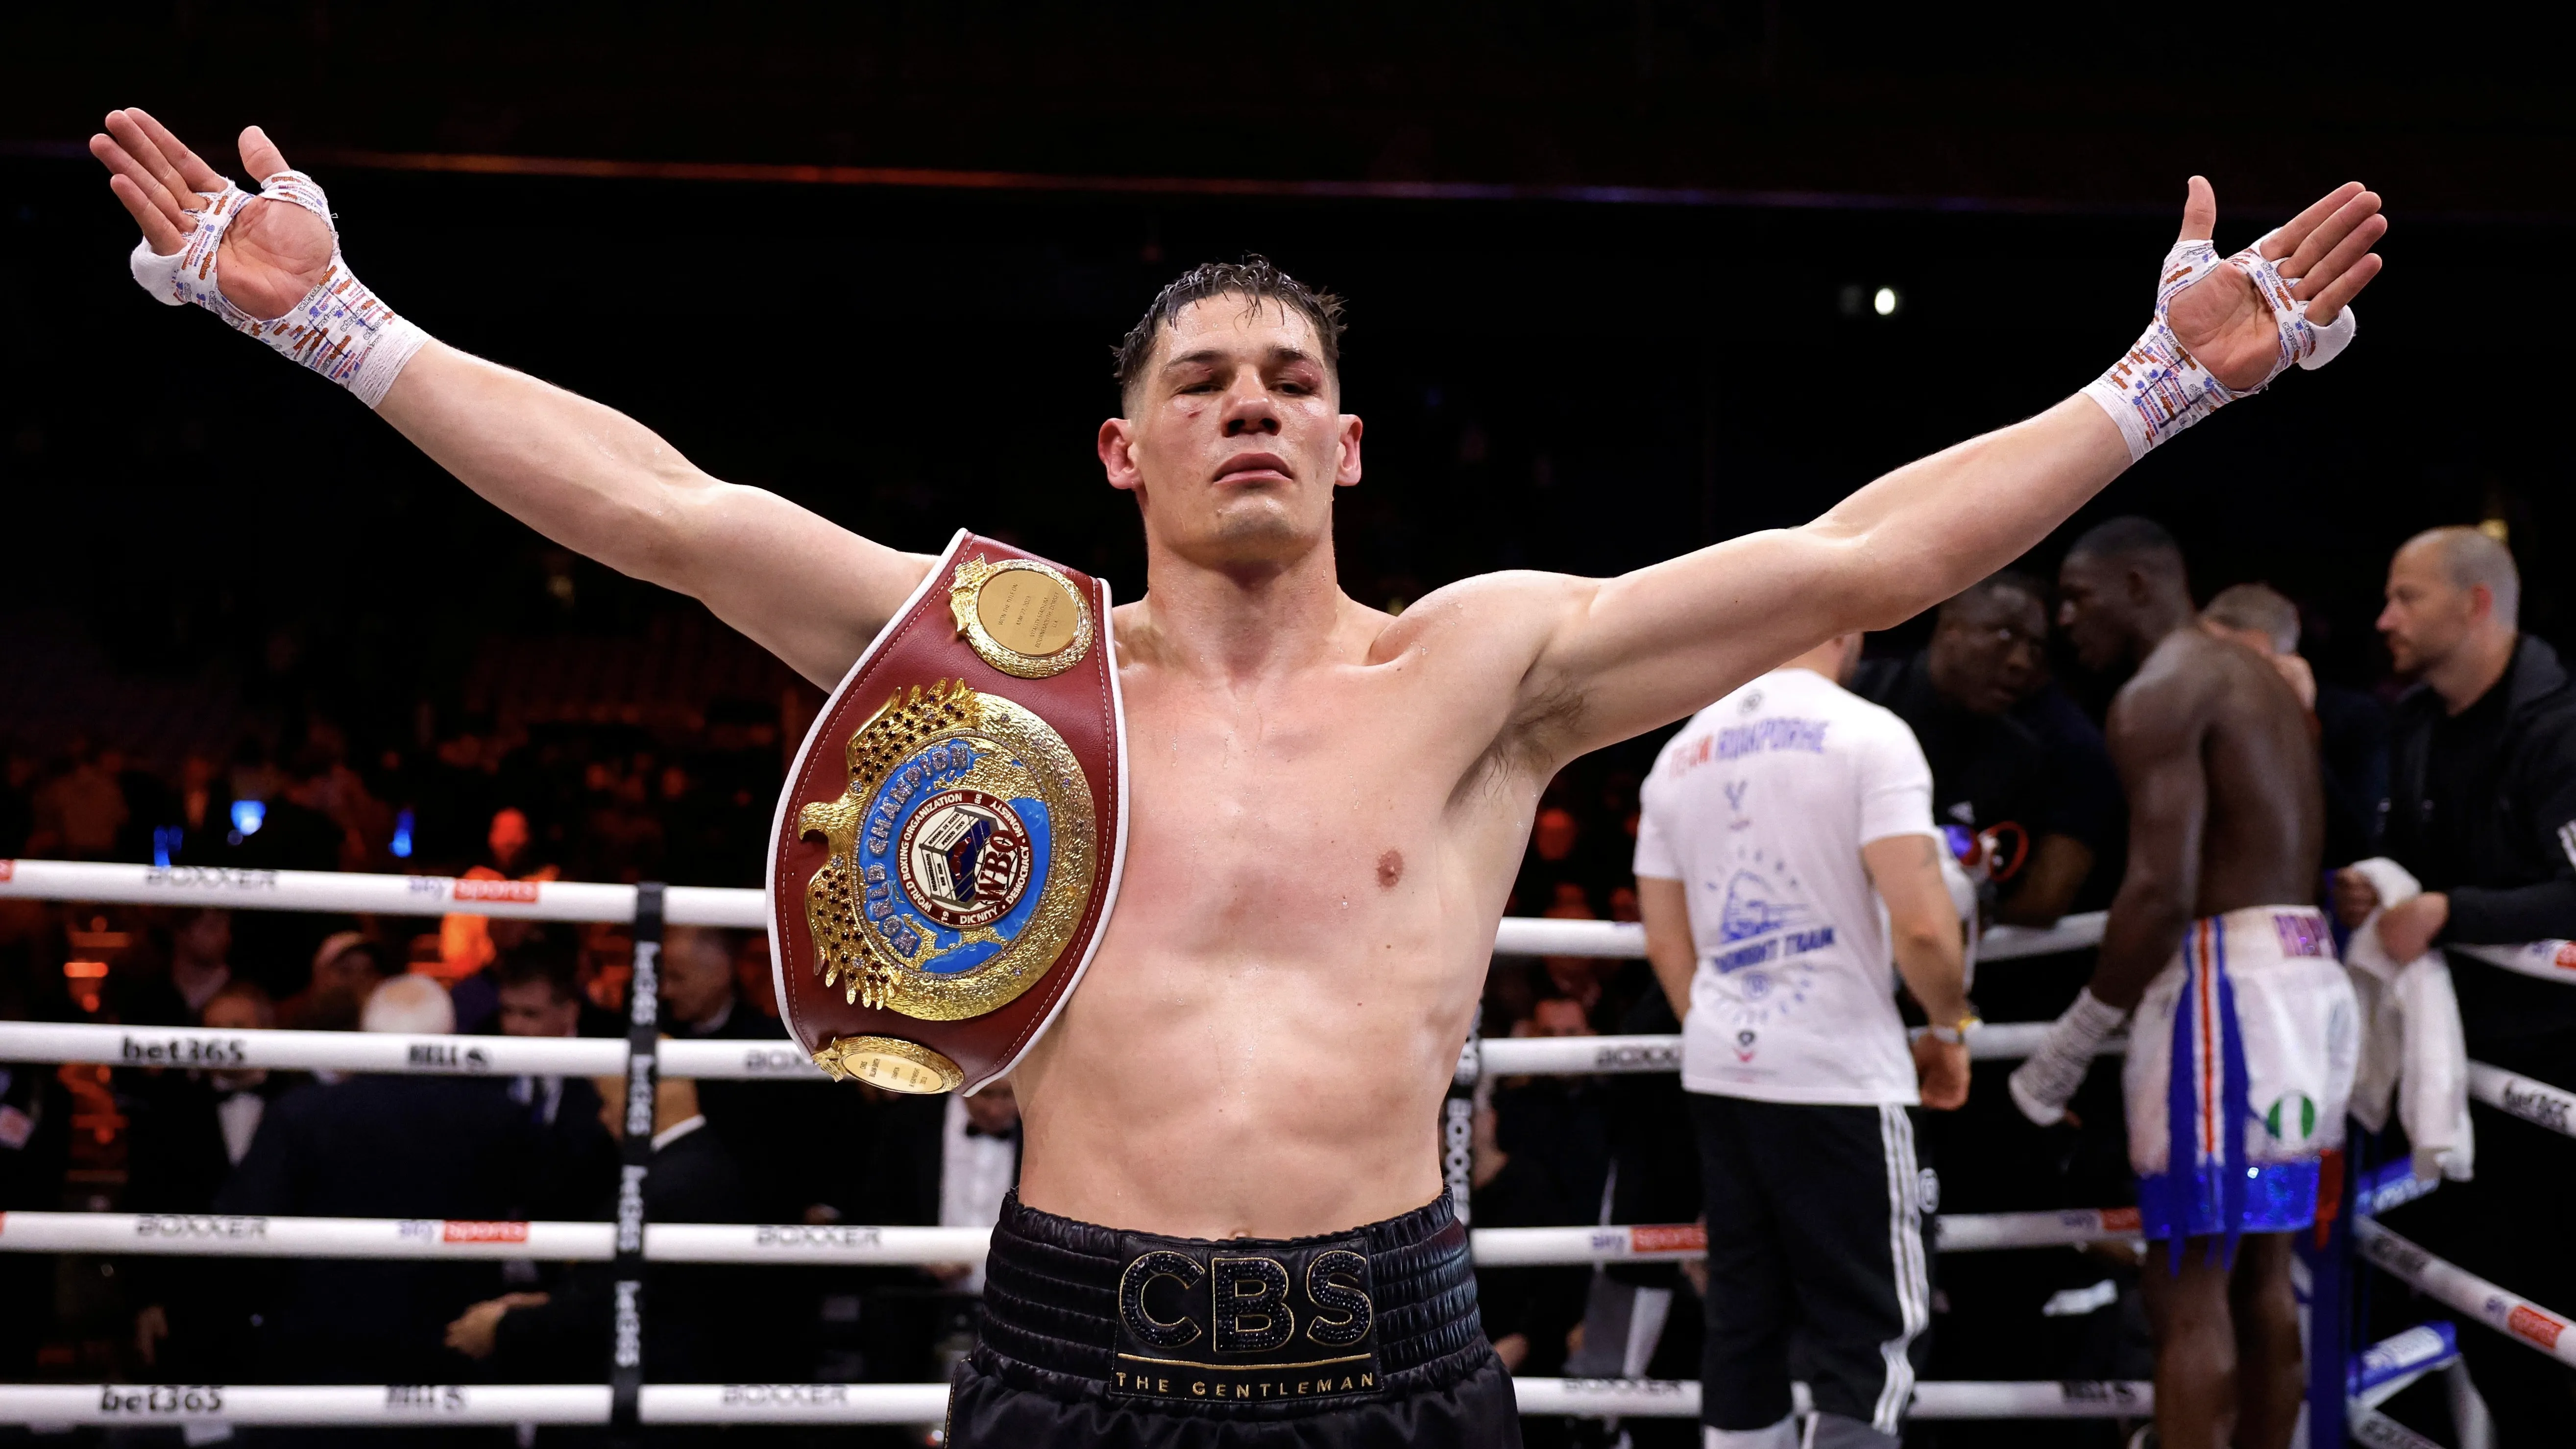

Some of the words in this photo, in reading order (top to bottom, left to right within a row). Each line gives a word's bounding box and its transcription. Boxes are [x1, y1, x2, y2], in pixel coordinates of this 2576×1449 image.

[188, 247, 198, 265] BRITISH
[197, 231, 206, 249] BOXING
[199, 251, 214, 280] empire
[998, 613, 1006, 625] WON
[1012, 583, 1018, 591] ON
[1049, 591, 1059, 610] DORSET
[1030, 618, 1039, 637] VITALITY
[868, 746, 969, 856] CHAMPION
[974, 793, 982, 804] 88
[903, 793, 962, 841] ORGANIZATION
[990, 800, 1024, 838] HONESTY
[900, 839, 910, 881] BOXING
[974, 830, 1018, 902] WBO
[1006, 846, 1029, 905] DEMOCRACY
[867, 864, 918, 958] WORLD
[906, 881, 932, 912] WORLD
[941, 911, 949, 921] 19
[960, 906, 997, 924] DIGNITY
[122, 1036, 246, 1064] bet365
[1119, 1250, 1373, 1353] CBS
[614, 1280, 642, 1368] bet365
[101, 1385, 223, 1412] bet365
[1116, 1372, 1169, 1393] THE
[1192, 1373, 1373, 1399] GENTLEMAN
